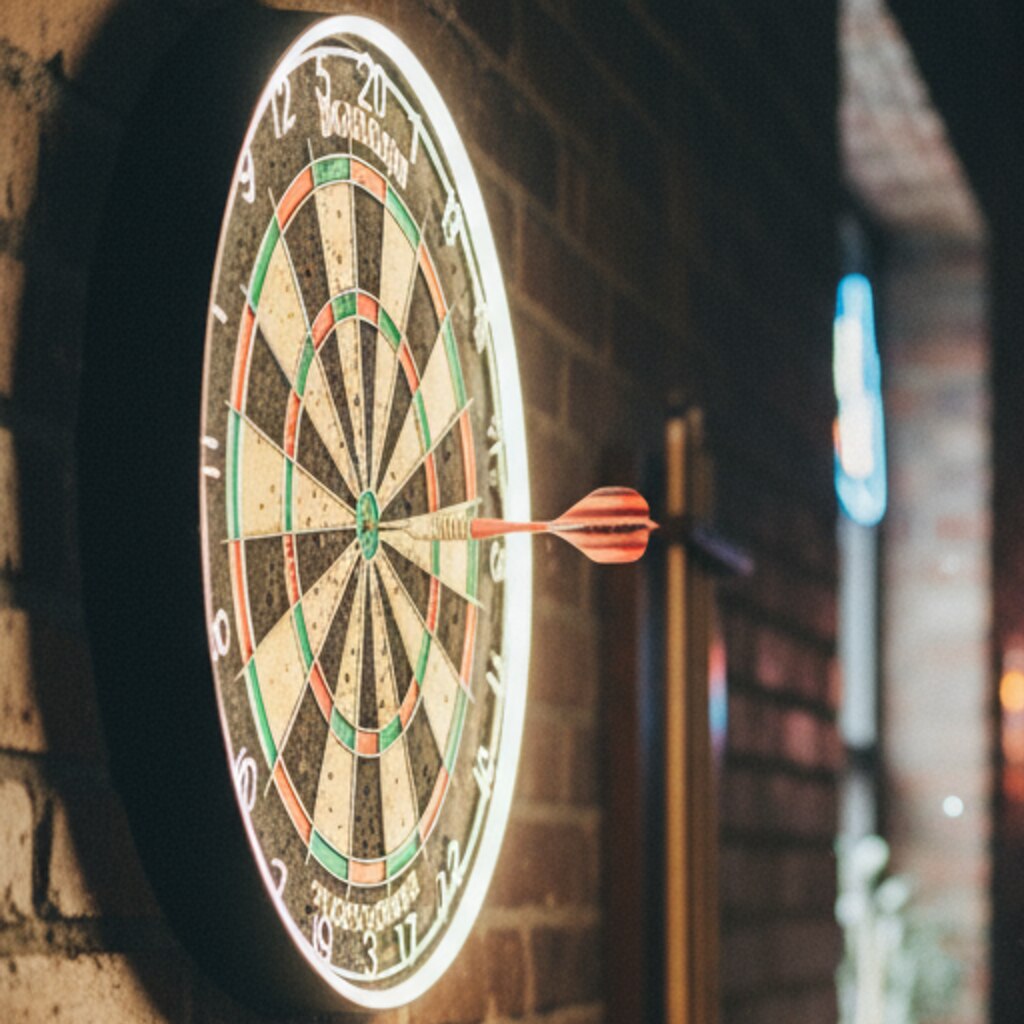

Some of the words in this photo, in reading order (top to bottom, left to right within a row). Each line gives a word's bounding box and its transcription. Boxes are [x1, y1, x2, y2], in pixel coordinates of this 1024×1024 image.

[272, 74, 297, 139] 12
[355, 54, 387, 119] 20
[363, 930, 378, 977] 3
